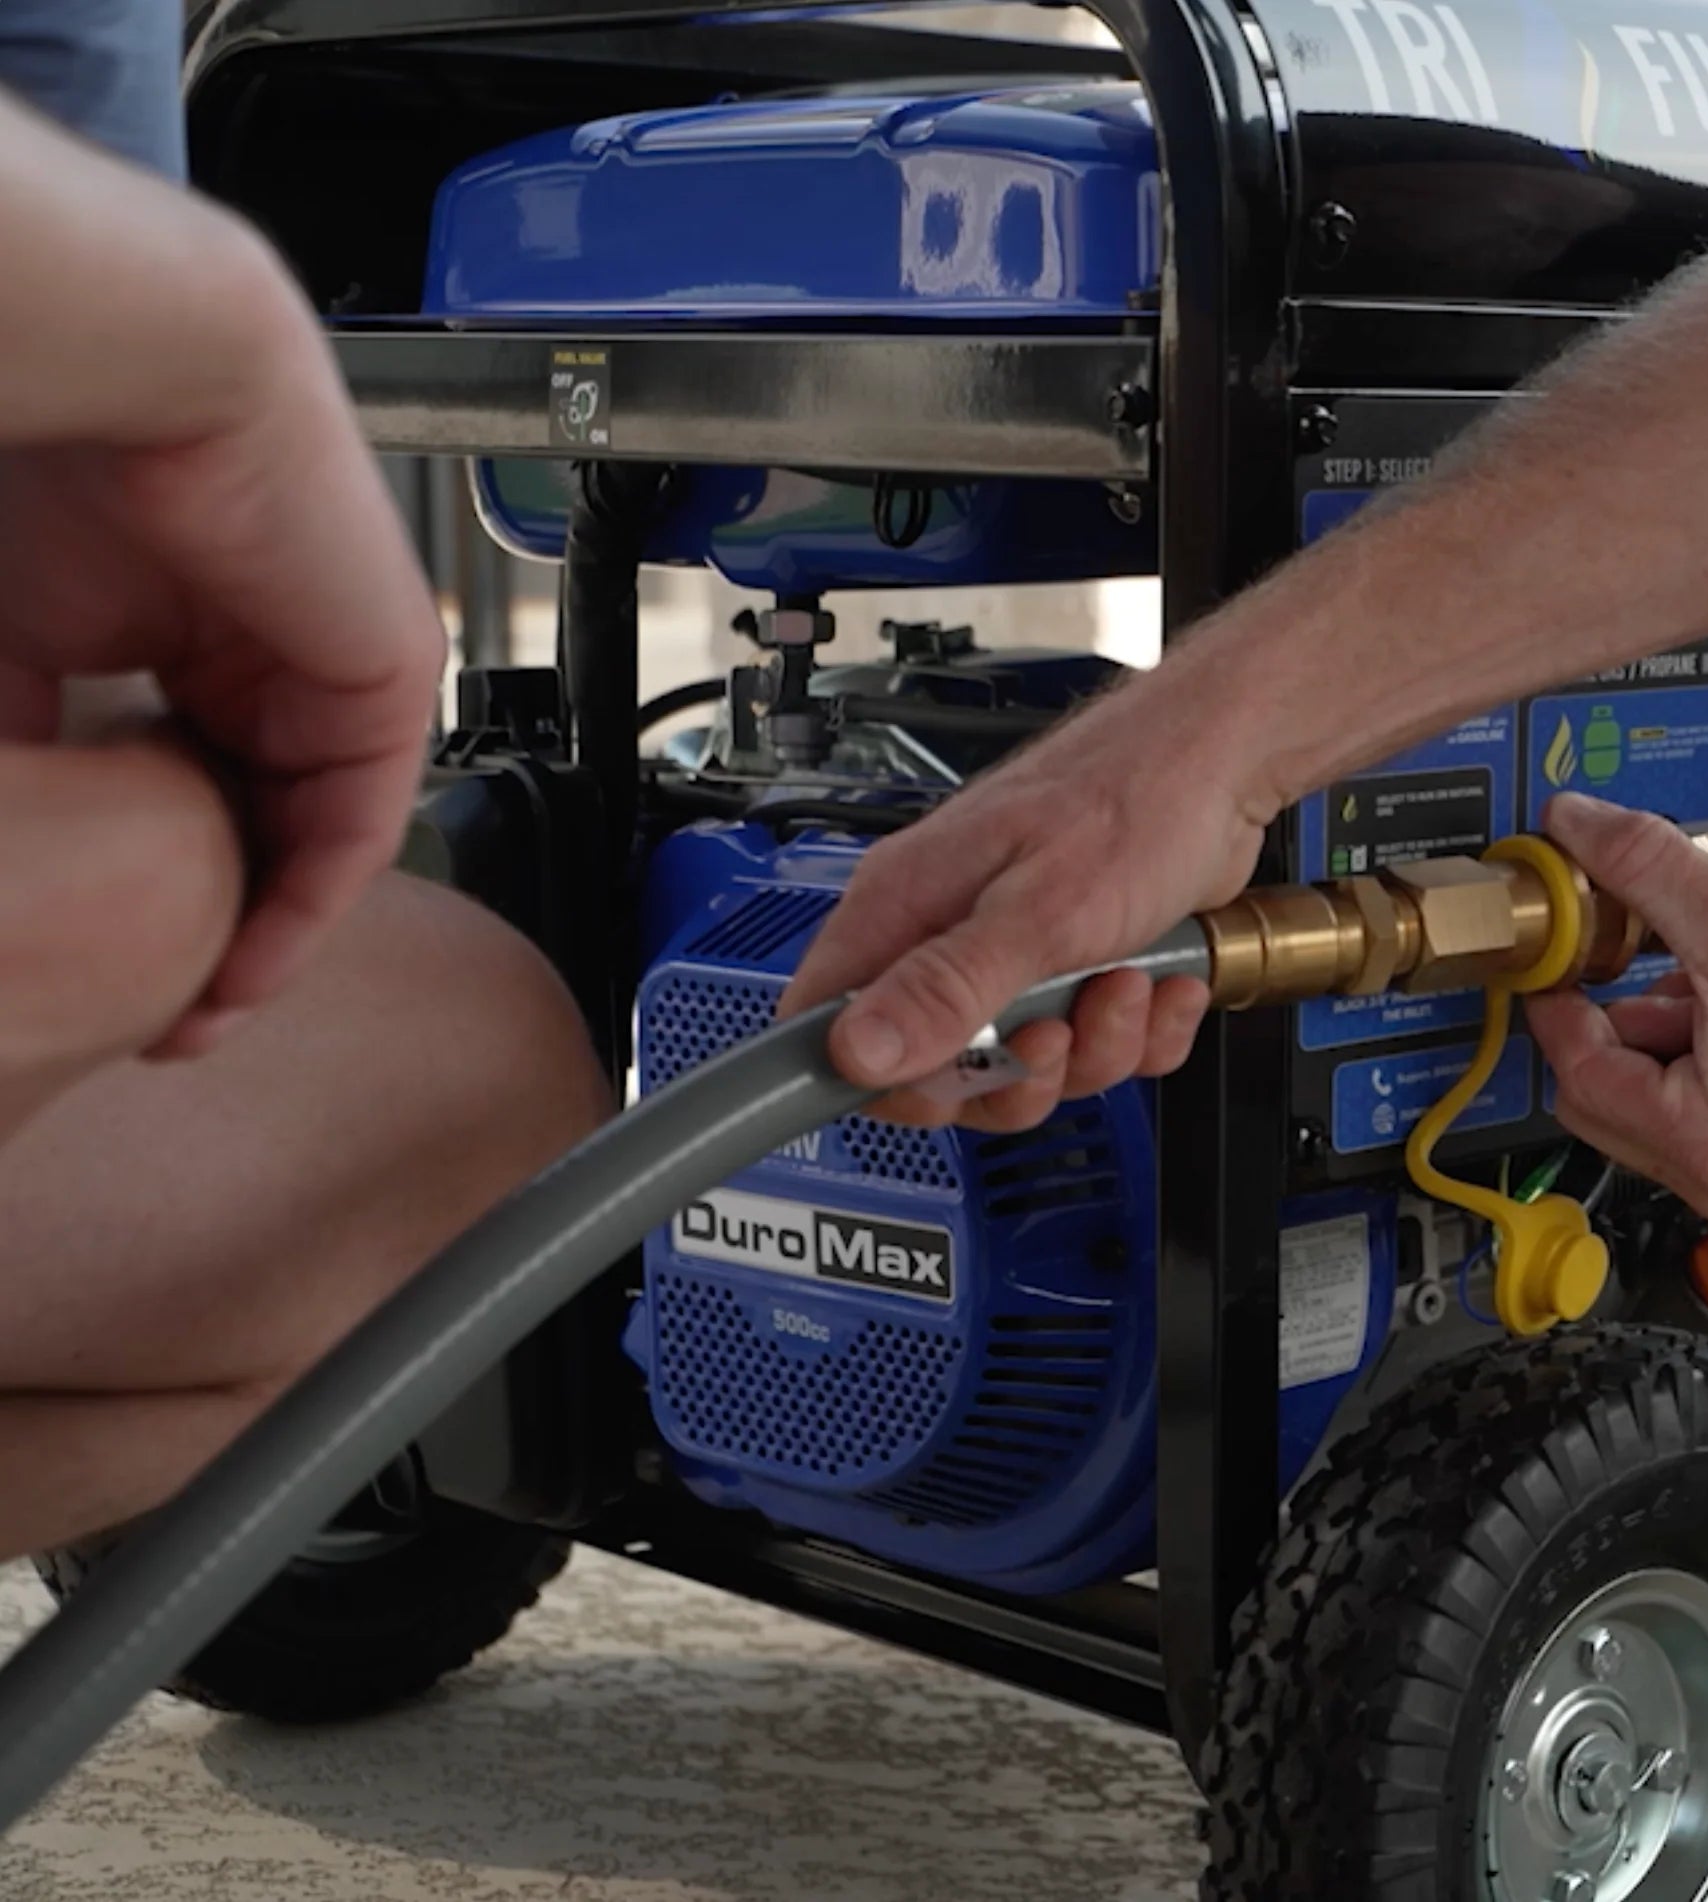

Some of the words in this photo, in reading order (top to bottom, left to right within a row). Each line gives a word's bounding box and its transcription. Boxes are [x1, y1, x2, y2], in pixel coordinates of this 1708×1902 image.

[1312, 0, 1500, 122] TRI
[551, 372, 574, 389] OFF
[589, 429, 609, 445] ON
[1323, 458, 1362, 483] STEP
[1380, 457, 1431, 482] SELECT
[1639, 654, 1699, 680] PROPANE
[774, 1131, 821, 1162] HV
[682, 1201, 946, 1287] DuroMax
[773, 1307, 831, 1342] 500cc
